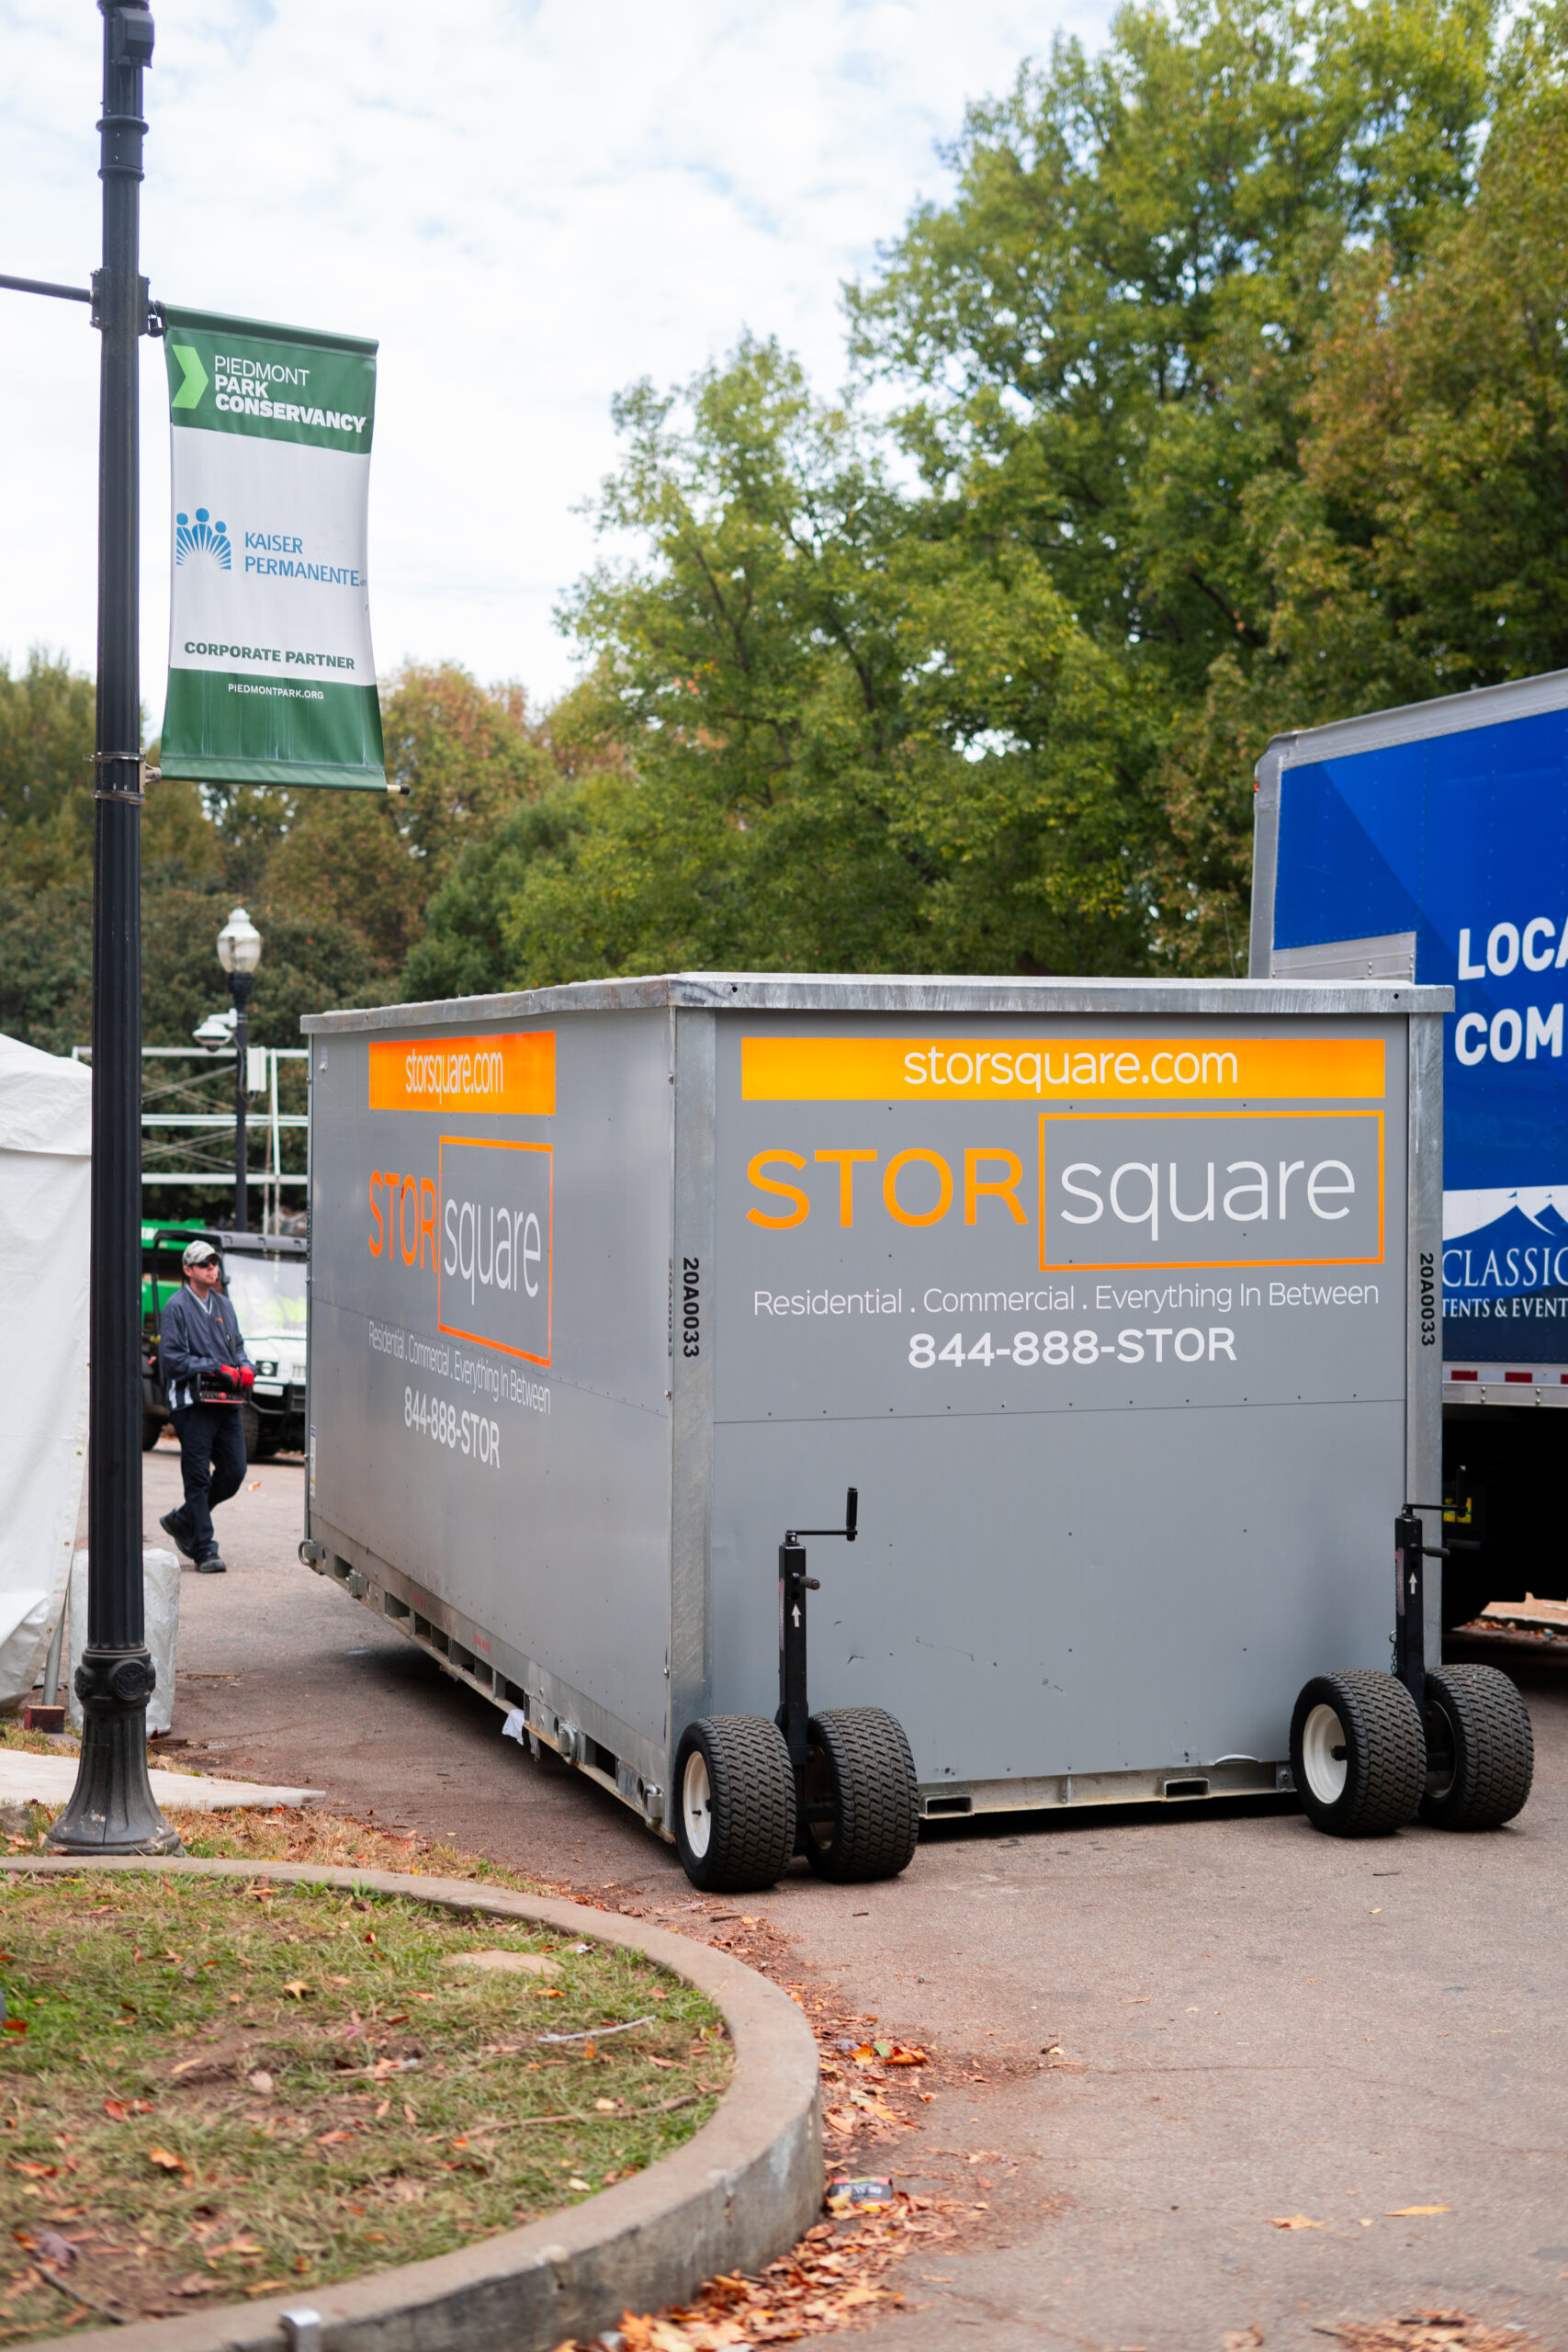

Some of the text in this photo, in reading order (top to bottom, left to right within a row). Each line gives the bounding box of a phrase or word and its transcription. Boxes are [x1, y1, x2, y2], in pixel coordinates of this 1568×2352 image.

[214, 355, 310, 387] PIEDMONT
[215, 373, 269, 399] PARK
[215, 393, 367, 434] CONSERVANCY
[244, 531, 303, 555] KAISER
[184, 640, 355, 671] CORPORATE PARTNER
[228, 683, 324, 700] PIEDMONTPARK.ORG
[405, 1047, 503, 1105] storsquare.com
[903, 1046, 1239, 1093] storsquare.com
[745, 1148, 1356, 1242] STOR square
[368, 1170, 437, 1273] STOR
[444, 1198, 541, 1306] square
[1442, 1246, 1568, 1288] CLASSIC
[682, 1257, 700, 1358] 20A0033
[753, 1287, 902, 1317] Residential
[923, 1285, 1075, 1313] Commercial
[1095, 1283, 1233, 1315] Everything
[1240, 1283, 1261, 1307] In
[1269, 1283, 1379, 1306] Between
[1419, 1252, 1436, 1347] 20A0033
[1442, 1297, 1491, 1318] TENTS
[1494, 1297, 1508, 1318] &
[368, 1321, 405, 1360] Residential
[408, 1334, 450, 1376] Commercial
[455, 1351, 500, 1403] Everything
[501, 1365, 509, 1399] In
[510, 1368, 551, 1415] Between
[908, 1328, 1238, 1370] 844-888-STOR
[404, 1385, 501, 1469] 844-888-STOR
